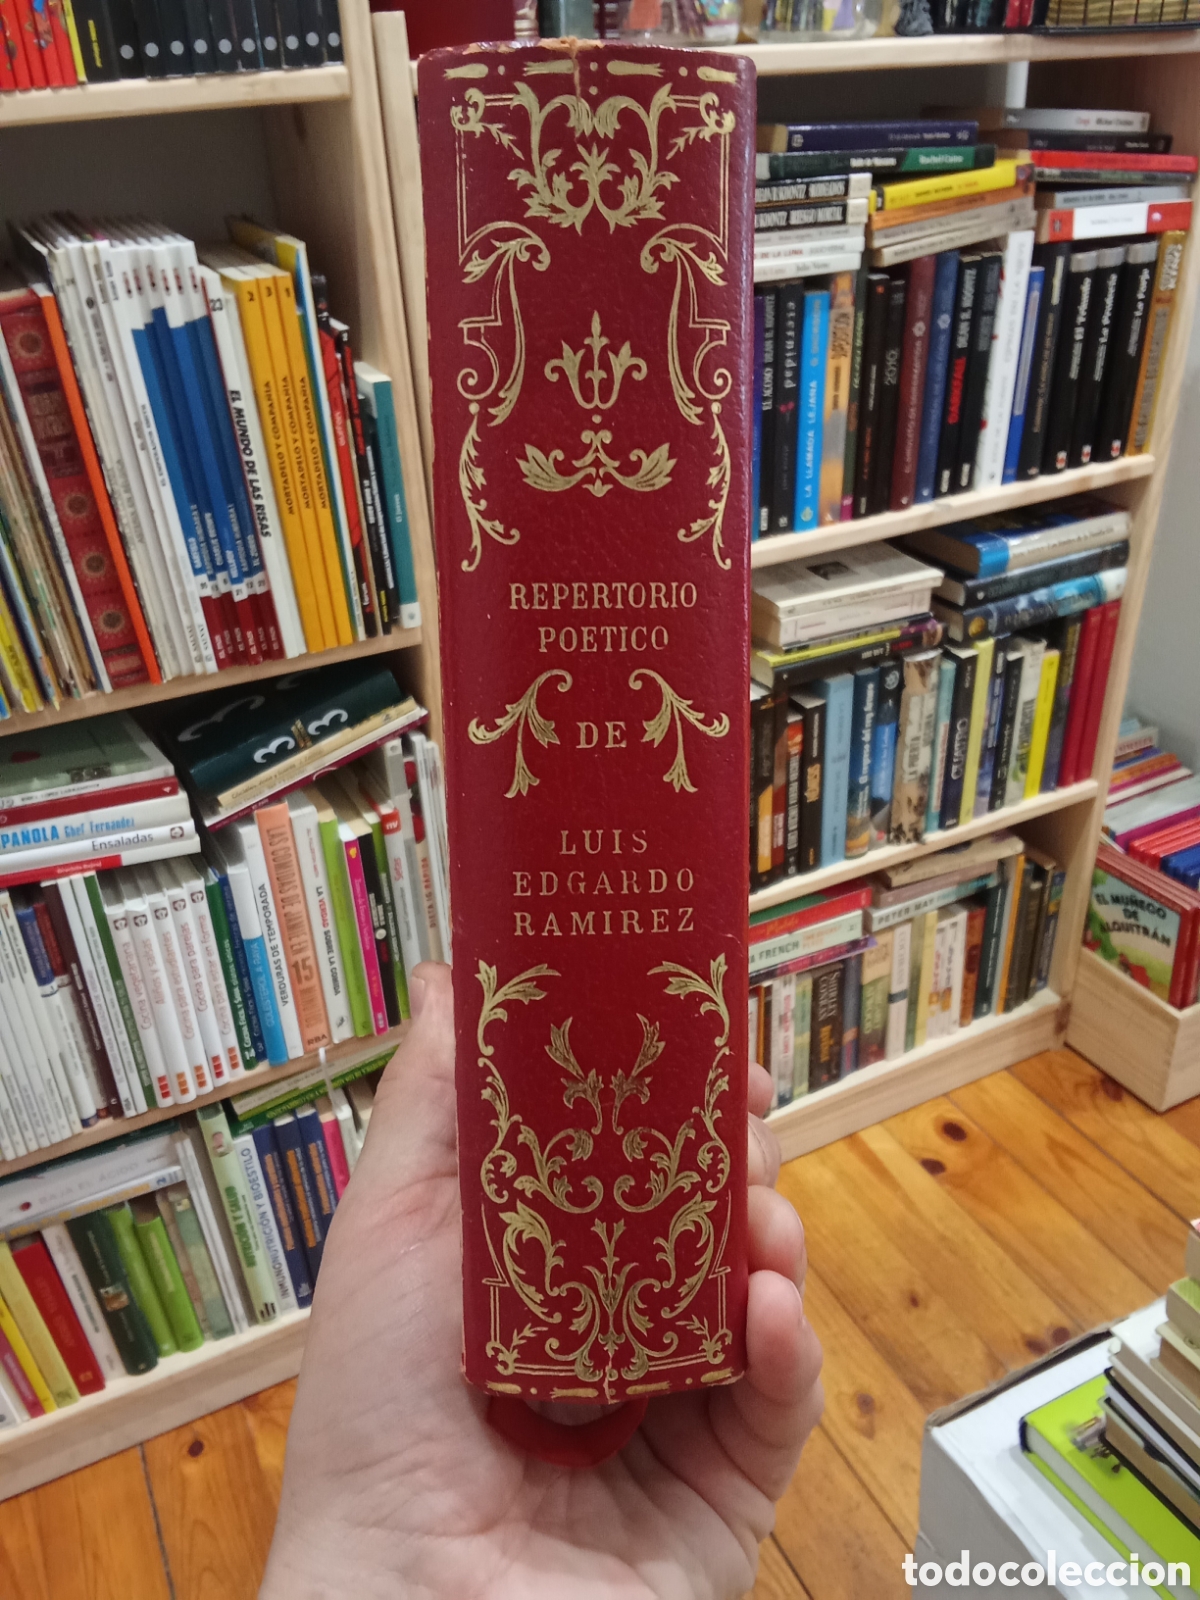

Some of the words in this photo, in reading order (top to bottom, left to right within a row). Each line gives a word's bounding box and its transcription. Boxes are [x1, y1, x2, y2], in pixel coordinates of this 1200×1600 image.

[785, 301, 797, 389] eternidad
[230, 390, 241, 403] EL
[809, 380, 818, 424] LEJANA
[233, 406, 253, 458] MUNDO
[276, 442, 281, 450] Y
[292, 438, 298, 446] Y
[309, 438, 315, 446] Y
[245, 460, 258, 476] DE
[805, 431, 815, 480] LLAMADA
[249, 478, 263, 502] LAS
[278, 462, 294, 515] MORTADELO
[295, 456, 311, 510] MORTADELO
[311, 457, 328, 509] MORTADELO
[805, 485, 812, 498] LA
[254, 503, 271, 538] RISAS
[509, 582, 697, 610] REPERTORIO
[538, 626, 669, 652] POETICO
[576, 721, 627, 749] DE
[951, 717, 968, 780] CUATRO
[908, 734, 922, 769] PUERTA
[906, 769, 917, 784] LA
[65, 822, 86, 839] Chef
[91, 832, 154, 852] Ensaladas
[266, 825, 287, 847] LAS
[560, 829, 648, 855] LUIS
[272, 845, 299, 894] COMIDAS
[513, 868, 694, 896] EDGARDO
[280, 894, 302, 910] DE
[316, 886, 324, 898] LA
[1095, 893, 1109, 906] EL
[1110, 892, 1167, 920] MUÑECO
[257, 883, 276, 942] TEMPORADA
[318, 899, 330, 929] VERDAD
[513, 907, 694, 936] RAMIREZ
[878, 906, 911, 925] PETER
[915, 898, 935, 912] MAY
[1122, 907, 1139, 921] DE
[179, 921, 197, 957] parejas
[196, 914, 212, 943] forma
[284, 909, 308, 943] JAMIE
[202, 943, 215, 956] en
[269, 943, 280, 957] DE
[291, 941, 309, 956] EN
[324, 930, 334, 954] SOBRE
[758, 941, 800, 960] FRENCH
[120, 940, 145, 998] vegetariana
[161, 930, 183, 986] estudiantes
[187, 957, 202, 980] para
[205, 955, 221, 982] estar
[328, 955, 336, 964] LA
[272, 958, 289, 1006] VERDURAS
[292, 960, 314, 985] 15
[330, 965, 341, 996] COMIDA
[173, 986, 187, 1008] para
[192, 981, 208, 1012] Cocina
[211, 982, 225, 1004] para
[257, 973, 274, 1027] COLESTEROL
[818, 976, 827, 1021] CONRAN
[831, 972, 841, 1018] SHIRLEY
[134, 998, 152, 1030] Cocina
[177, 1008, 194, 1040] Cocina
[216, 1004, 232, 1035] Cocina
[307, 1033, 327, 1045] RBA
[239, 1147, 263, 1201] BIOESTILO
[255, 1201, 266, 1210] Y
